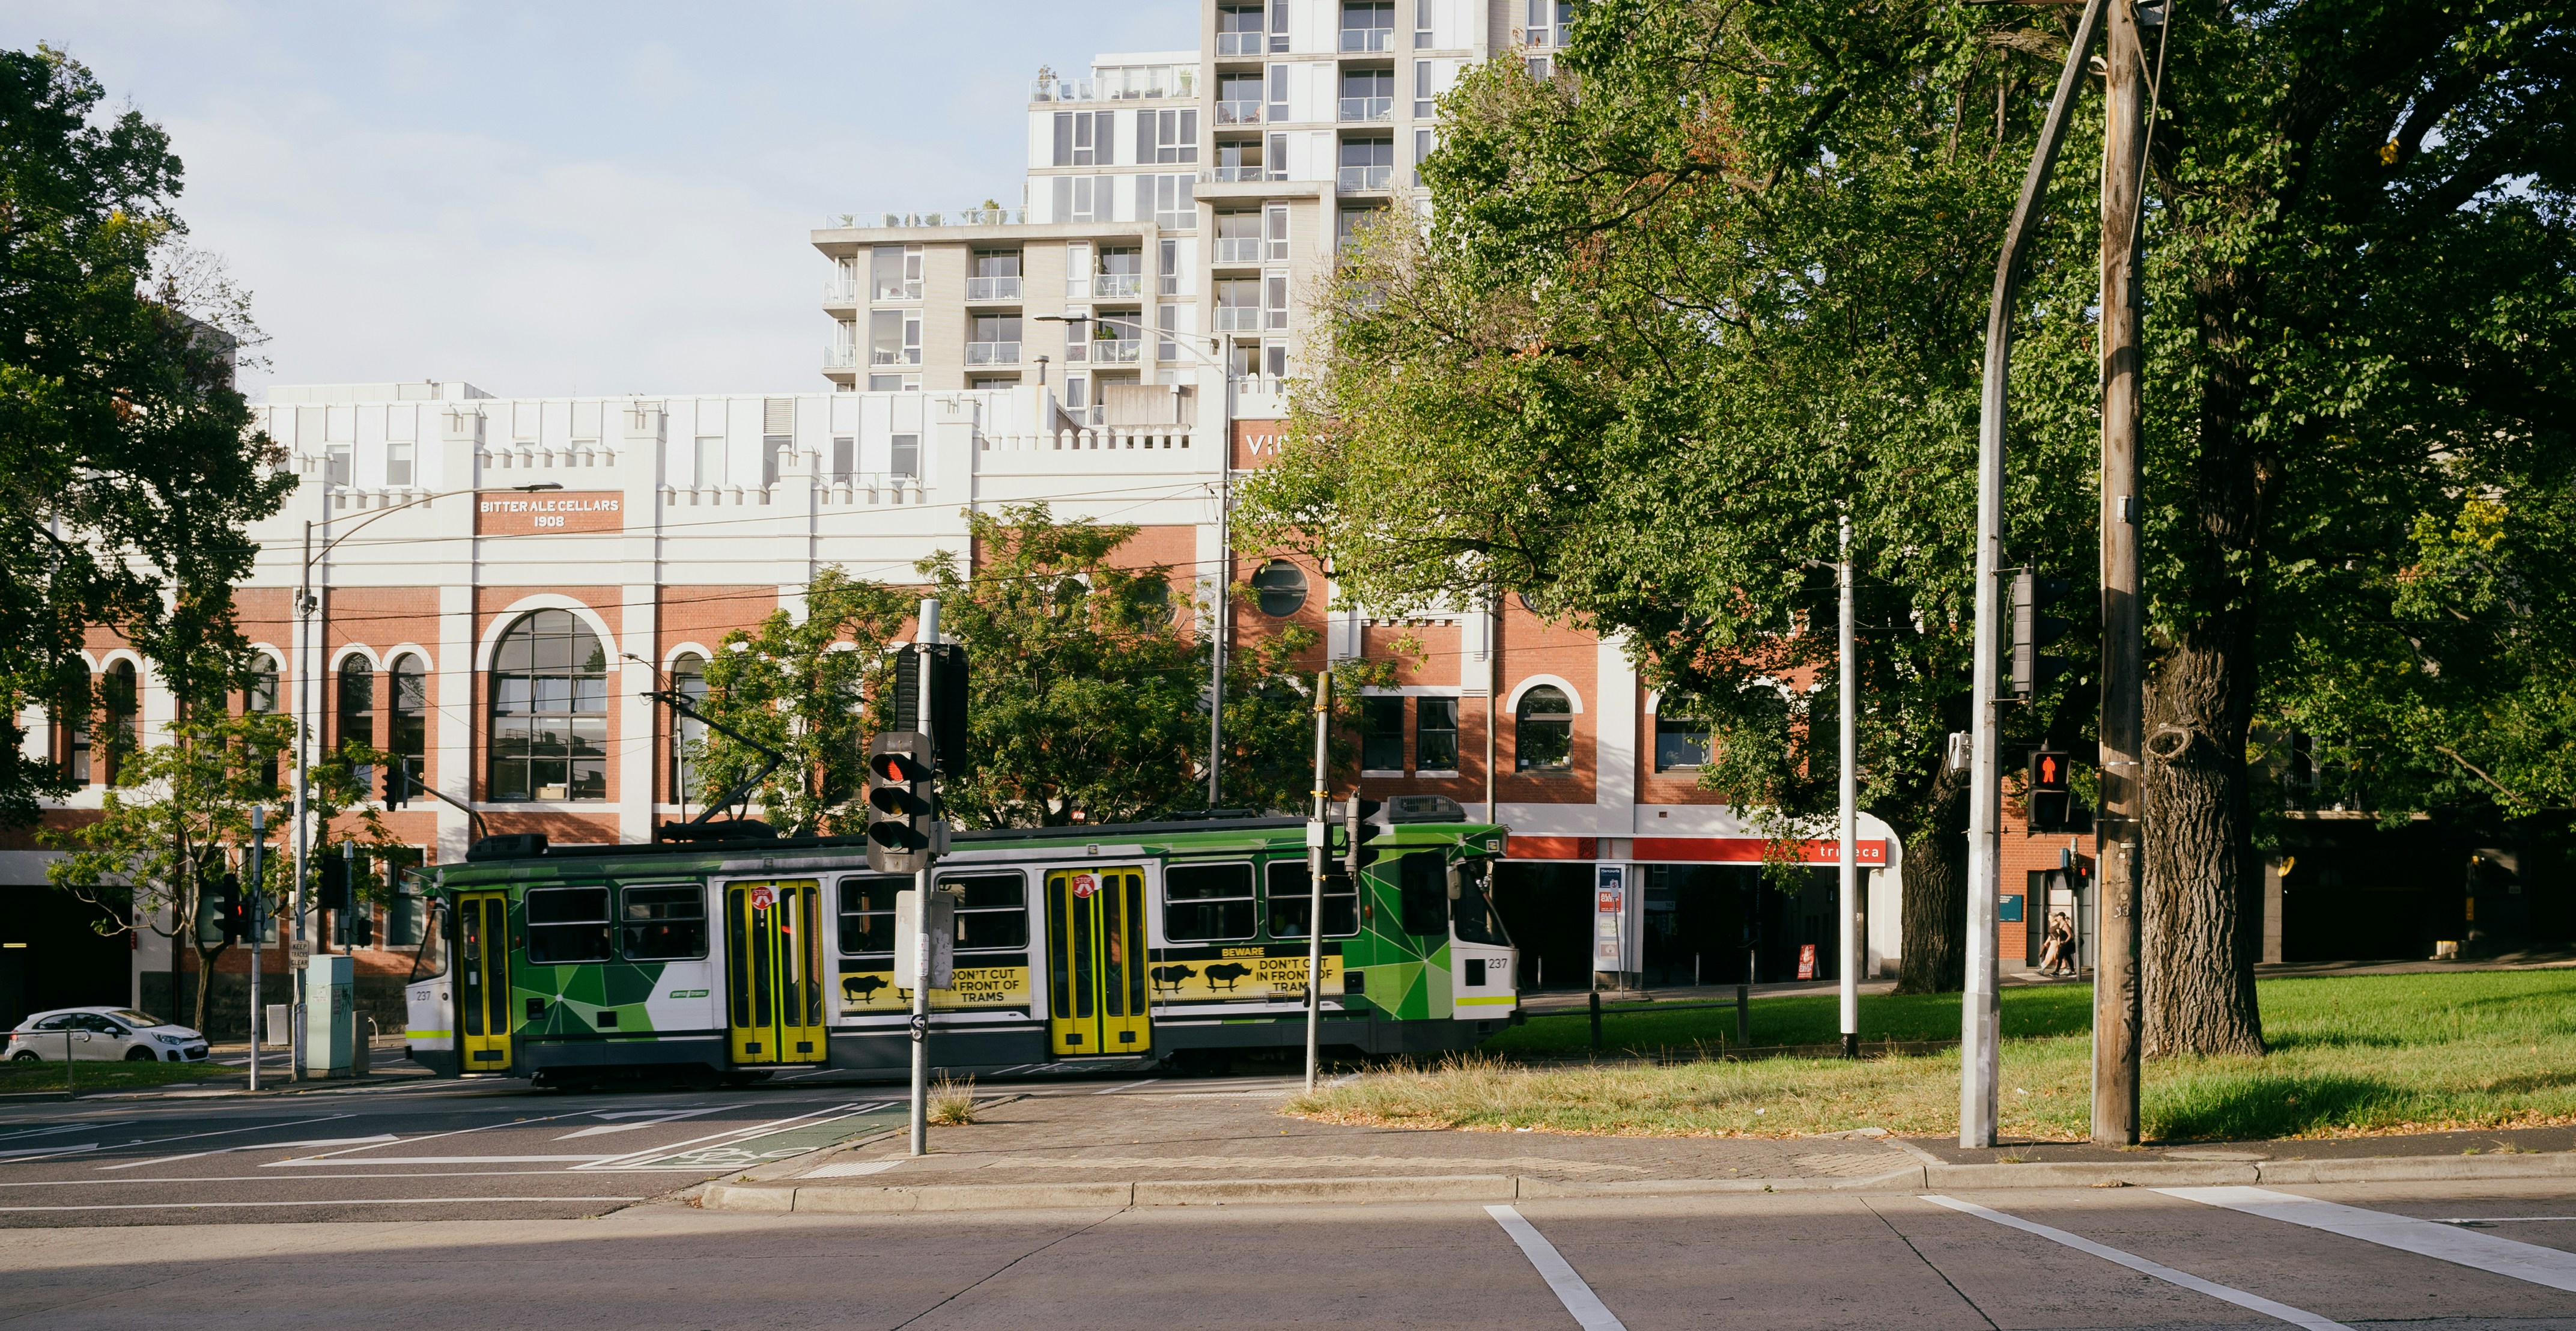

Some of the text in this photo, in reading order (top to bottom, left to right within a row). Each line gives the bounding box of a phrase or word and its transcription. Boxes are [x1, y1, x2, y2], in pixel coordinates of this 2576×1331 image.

[481, 500, 620, 513] BITTER ALE CELLARS
[534, 516, 565, 528] 1908
[1820, 846, 1879, 857] trieca
[1222, 948, 1265, 957] BEWARE
[1260, 958, 1329, 970] DON'T CT
[1489, 958, 1507, 969] 237
[991, 969, 1015, 979] CUT
[1256, 972, 1268, 981] IN
[1272, 970, 1311, 981] FRONT
[961, 981, 1001, 991] FRONT
[1003, 980, 1019, 990] OF
[416, 991, 431, 1001] 237
[961, 992, 1004, 1002] TRAMS
